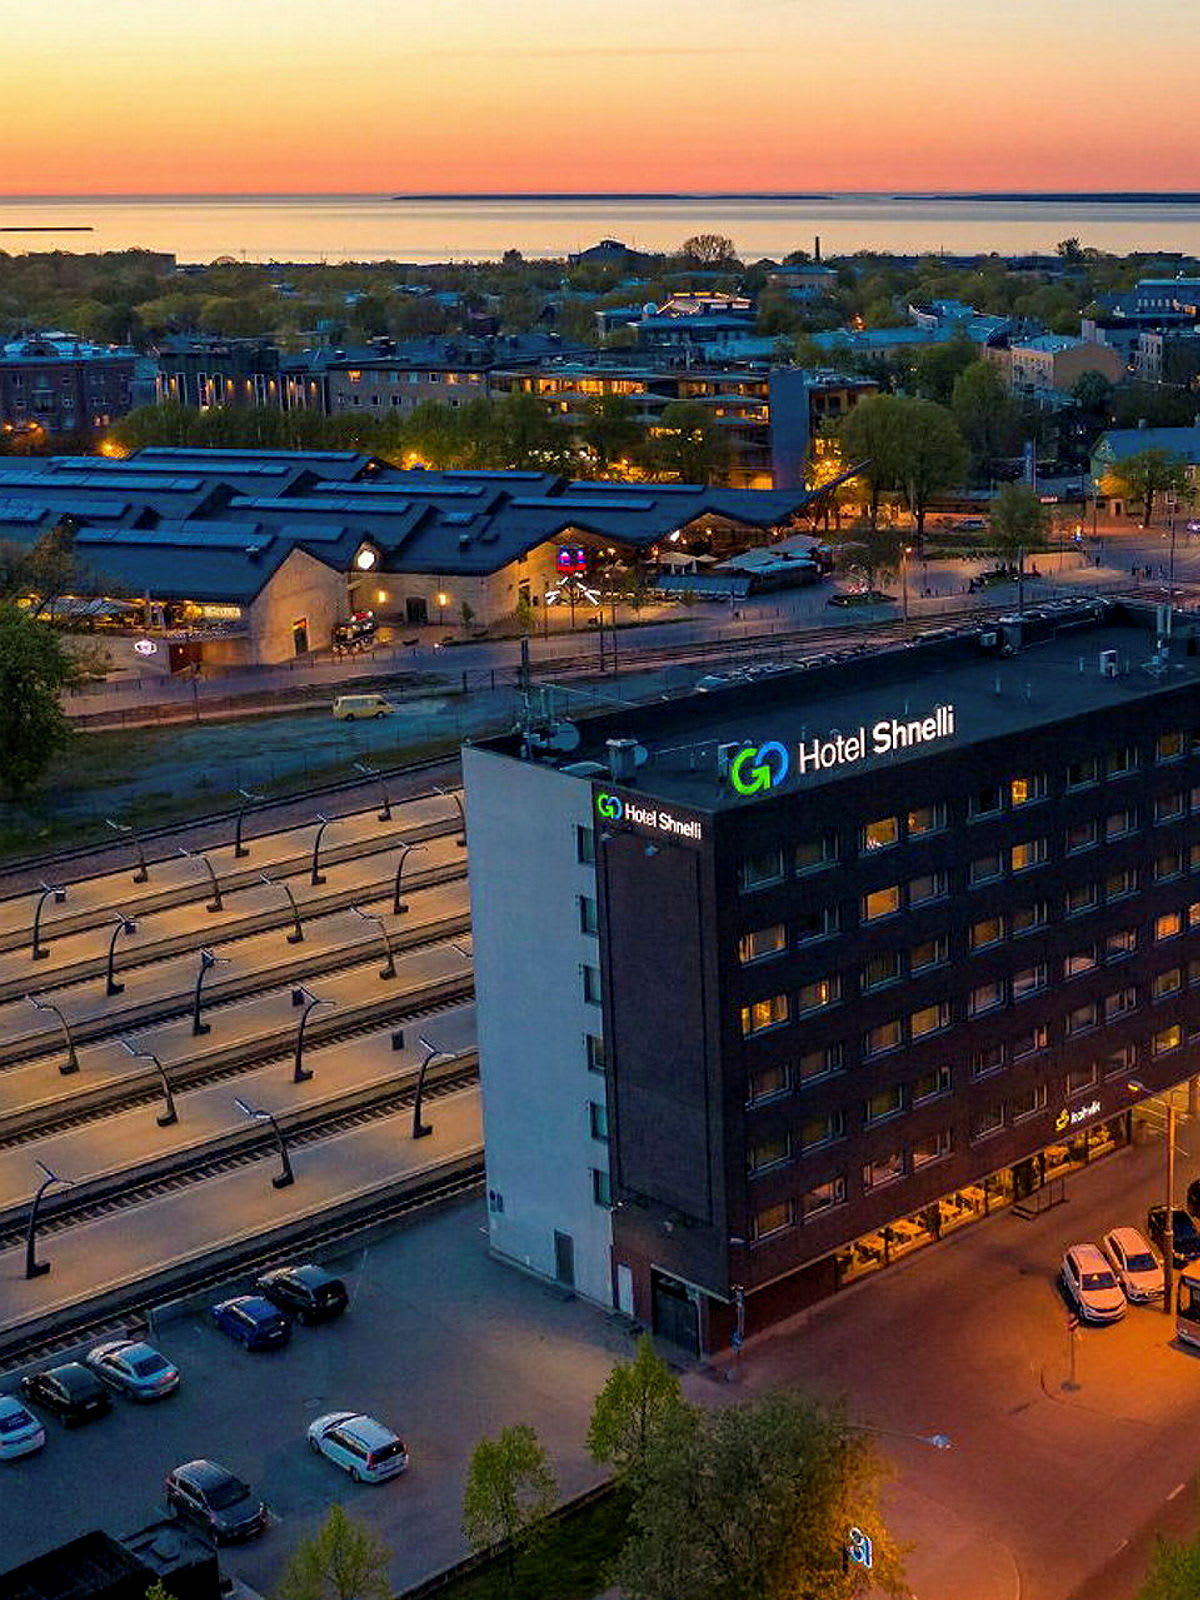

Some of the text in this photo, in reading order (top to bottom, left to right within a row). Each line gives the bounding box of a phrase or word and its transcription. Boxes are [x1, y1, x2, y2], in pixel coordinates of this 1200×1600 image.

[799, 727, 866, 774] Hotel
[872, 705, 955, 754] Shnelli
[625, 802, 657, 828] Hotel
[659, 812, 702, 840] Shnelli
